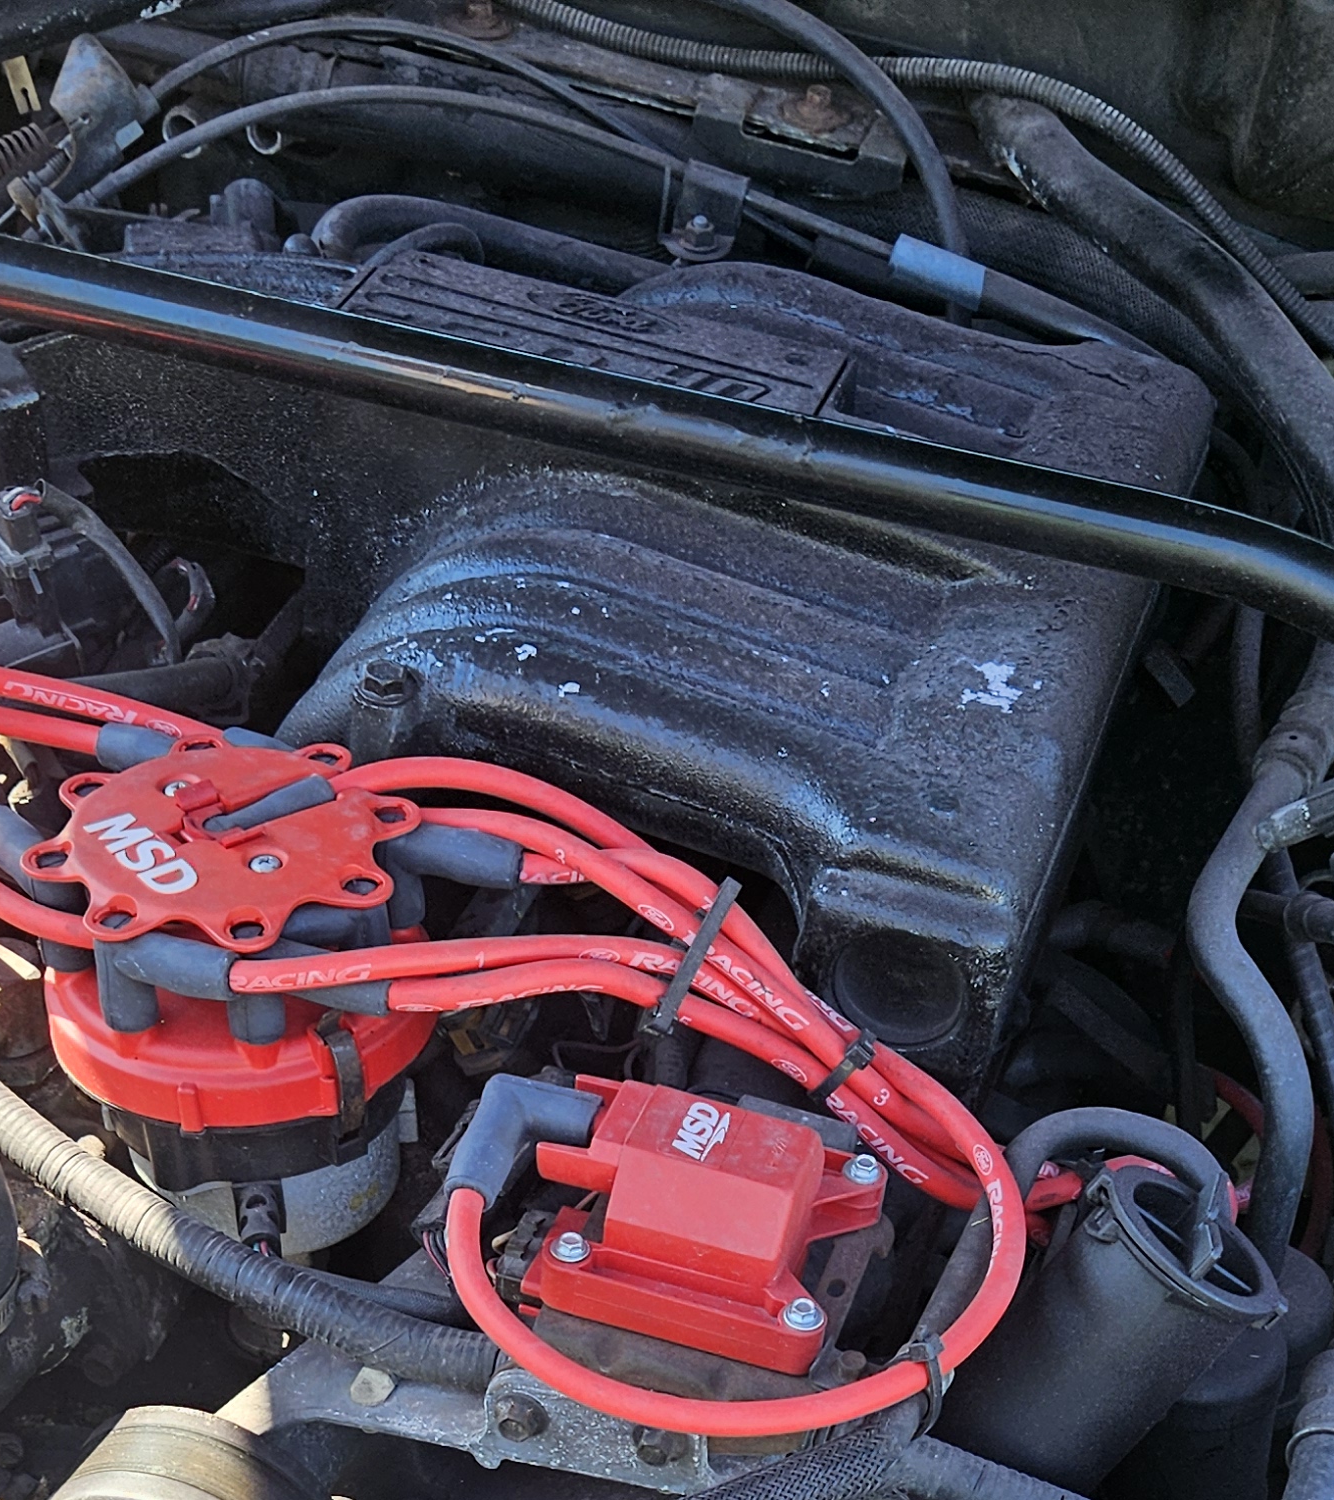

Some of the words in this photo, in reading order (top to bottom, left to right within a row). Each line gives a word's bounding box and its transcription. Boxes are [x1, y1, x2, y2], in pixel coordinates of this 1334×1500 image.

[3, 681, 138, 724] RACING
[83, 812, 198, 895] MSD
[230, 963, 372, 989] RACING
[873, 1088, 890, 1106] 3
[672, 1102, 720, 1160] MSD
[827, 1097, 928, 1184] RACING
